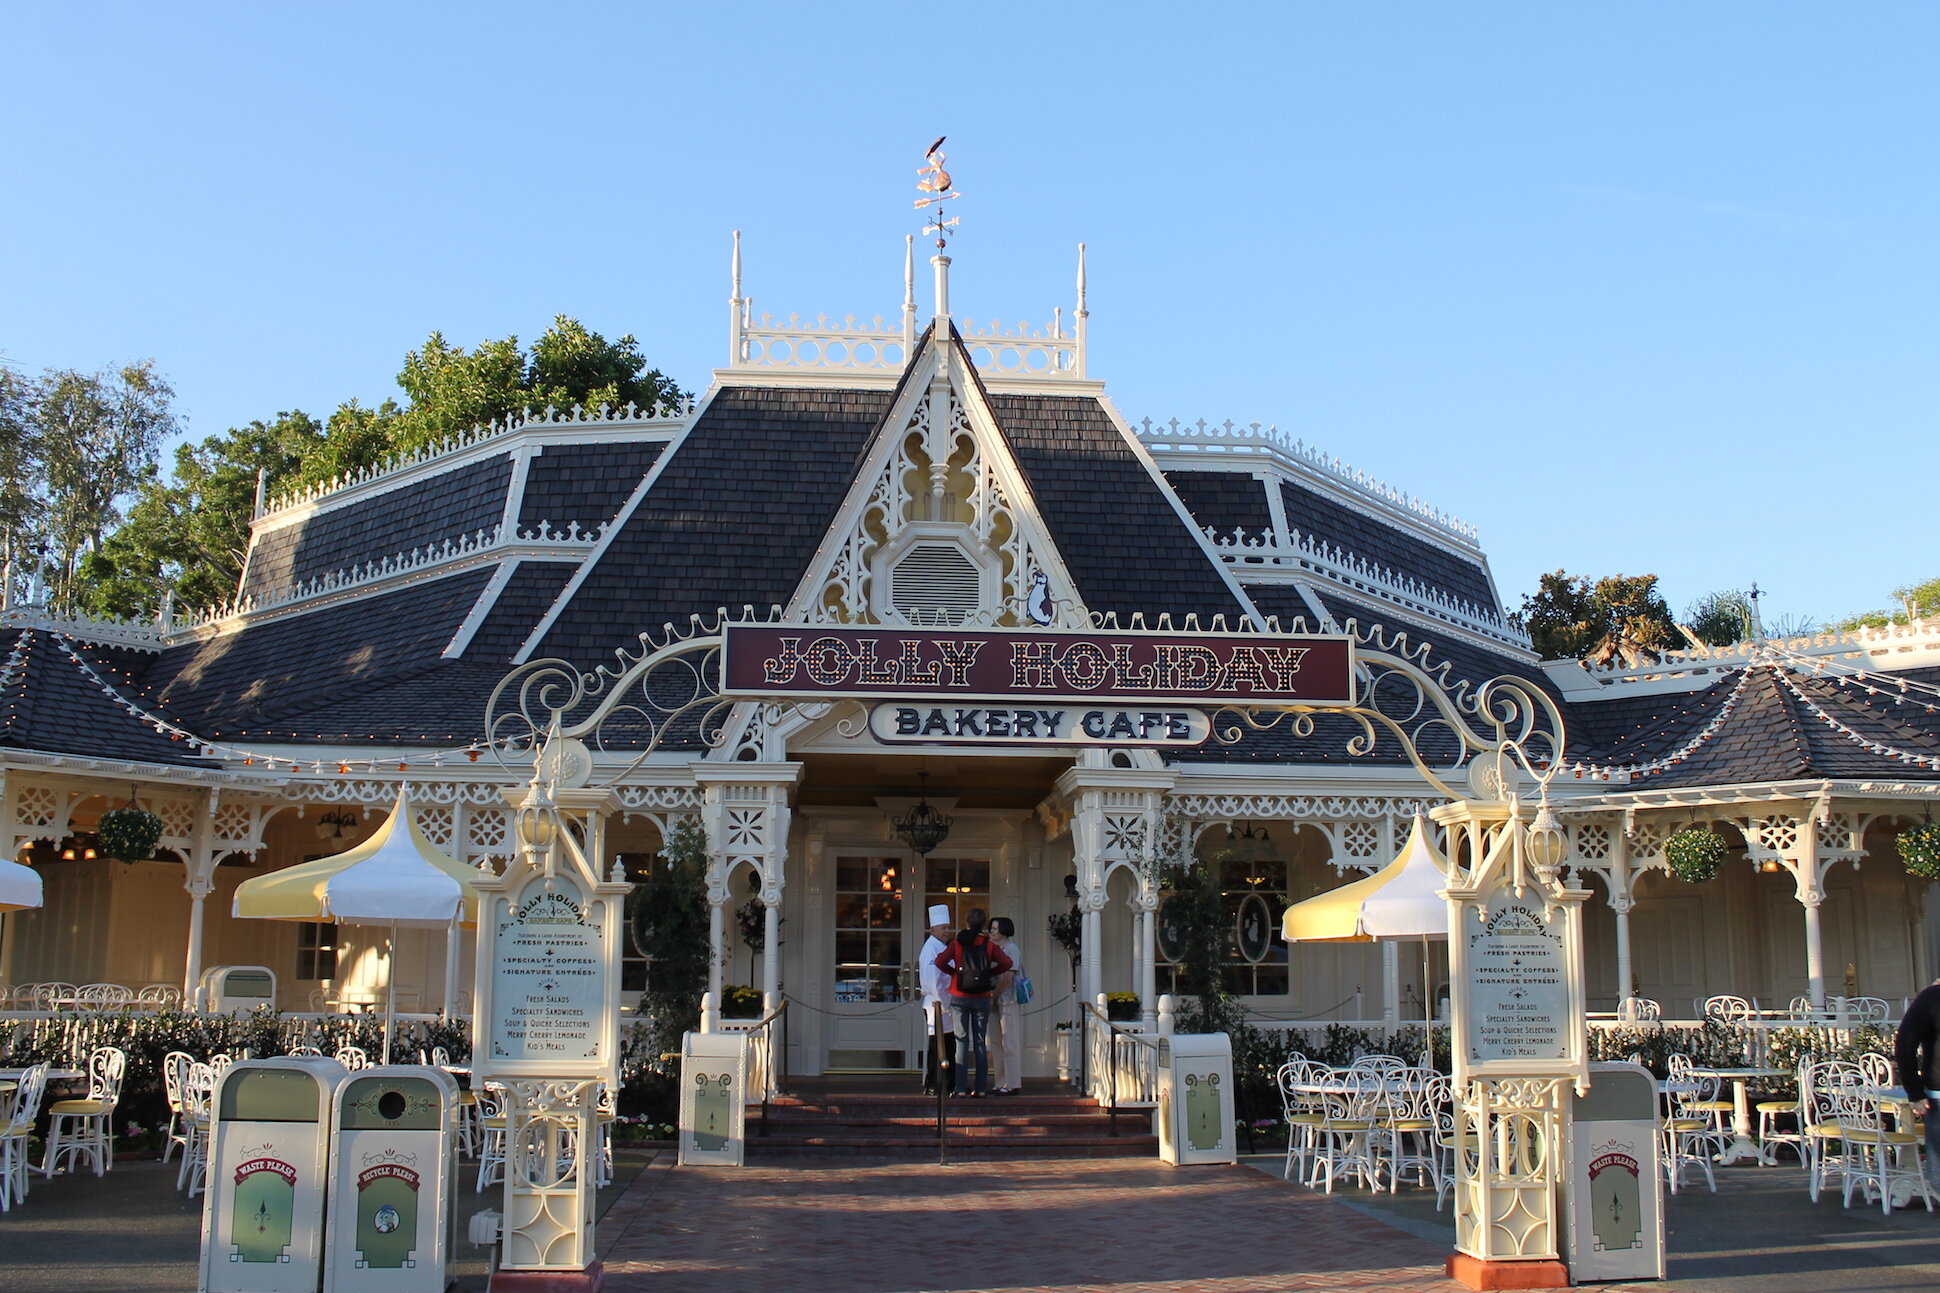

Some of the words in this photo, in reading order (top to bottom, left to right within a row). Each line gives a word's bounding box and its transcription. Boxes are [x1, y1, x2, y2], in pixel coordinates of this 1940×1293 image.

[763, 636, 988, 687] JOLLY
[1008, 641, 1311, 693] HOLIDAY
[894, 707, 1063, 738] BAKERY
[1080, 710, 1190, 739] CAFE
[517, 895, 542, 926] JOLLY
[548, 894, 585, 926] HOLIDAY
[1486, 907, 1507, 936] JOLLY
[1512, 906, 1547, 937] HOLIDAY
[504, 1019, 520, 1027] SOUP
[530, 1019, 552, 1027] QUICHE
[555, 1019, 590, 1027] SELECTIONS
[239, 1161, 265, 1175] WASTE
[266, 1161, 294, 1177] PLEASE
[362, 1166, 390, 1181] RECYCLE
[392, 1167, 416, 1182] PLEASE
[1591, 1156, 1613, 1170] WASTE
[1614, 1156, 1637, 1170] PLEASE
